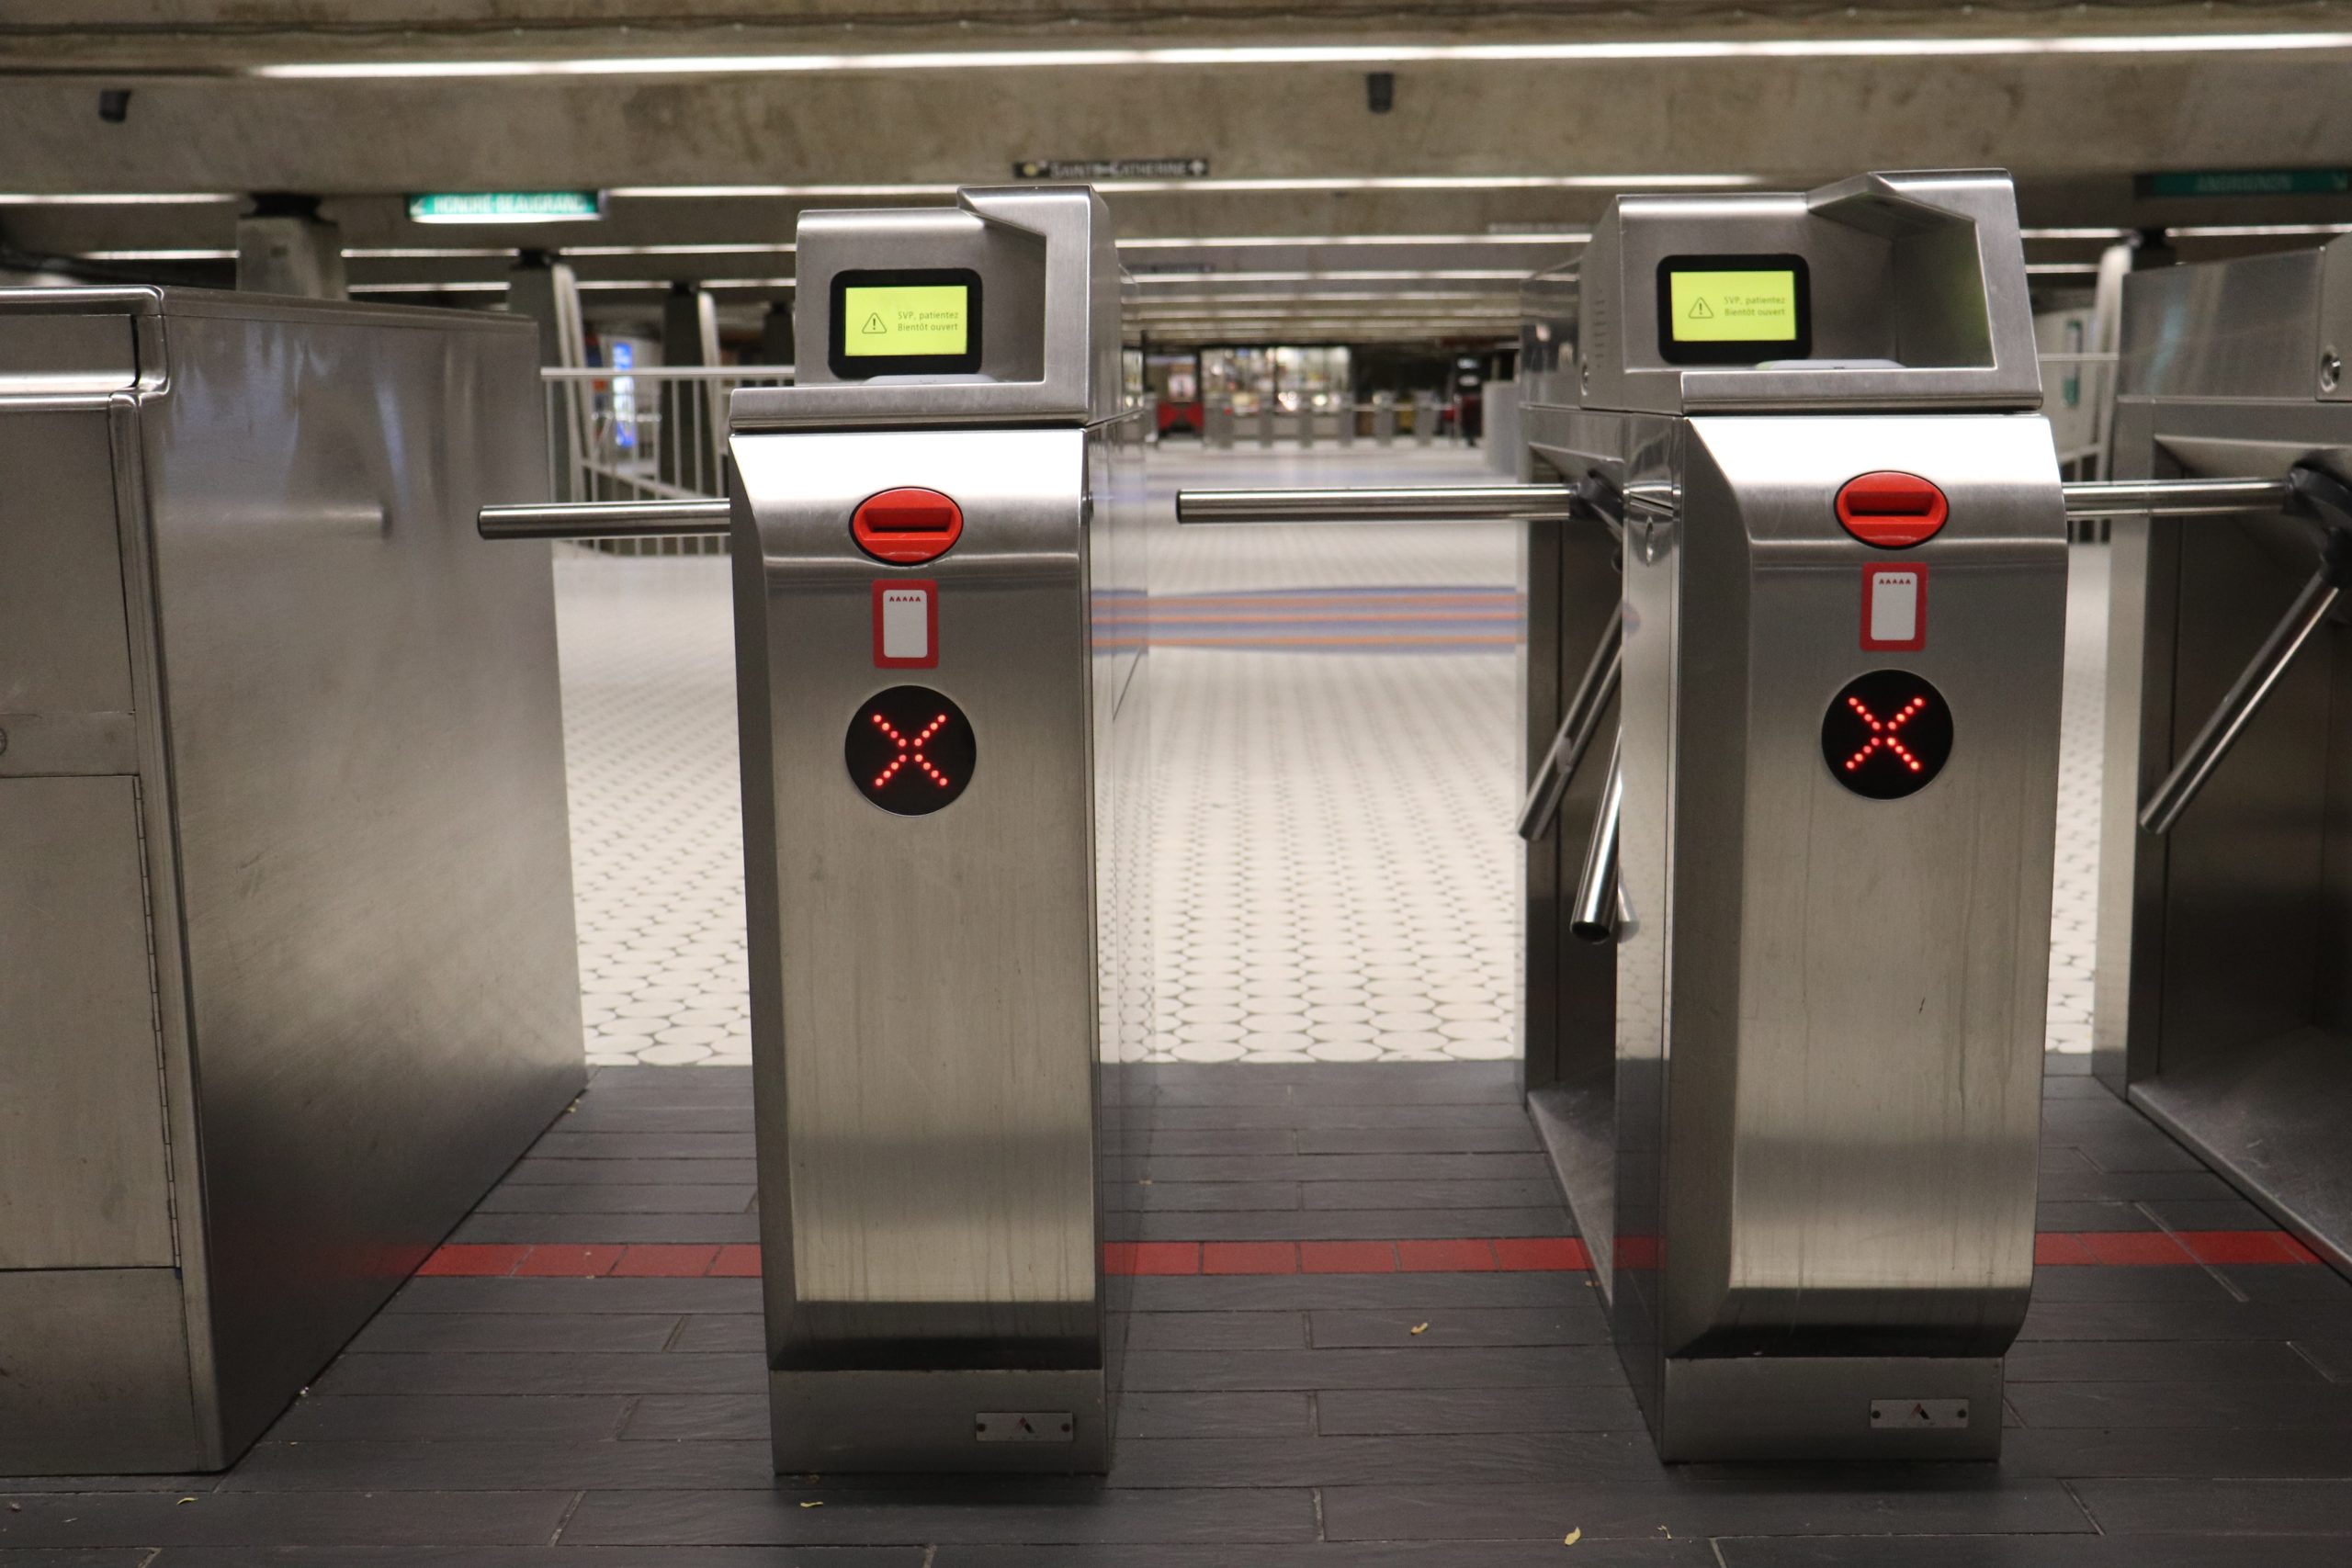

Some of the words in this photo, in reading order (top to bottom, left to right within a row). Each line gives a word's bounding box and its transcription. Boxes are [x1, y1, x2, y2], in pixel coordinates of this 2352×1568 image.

[1724, 296, 1743, 305] SVP,
[1746, 296, 1785, 306] patientez
[898, 310, 916, 321] SVP,
[919, 310, 958, 321] patientez
[1724, 308, 1755, 317] Bientôt
[1758, 308, 1785, 316] ouvert
[898, 322, 928, 332] Bientôt
[932, 322, 958, 331] ouvert
